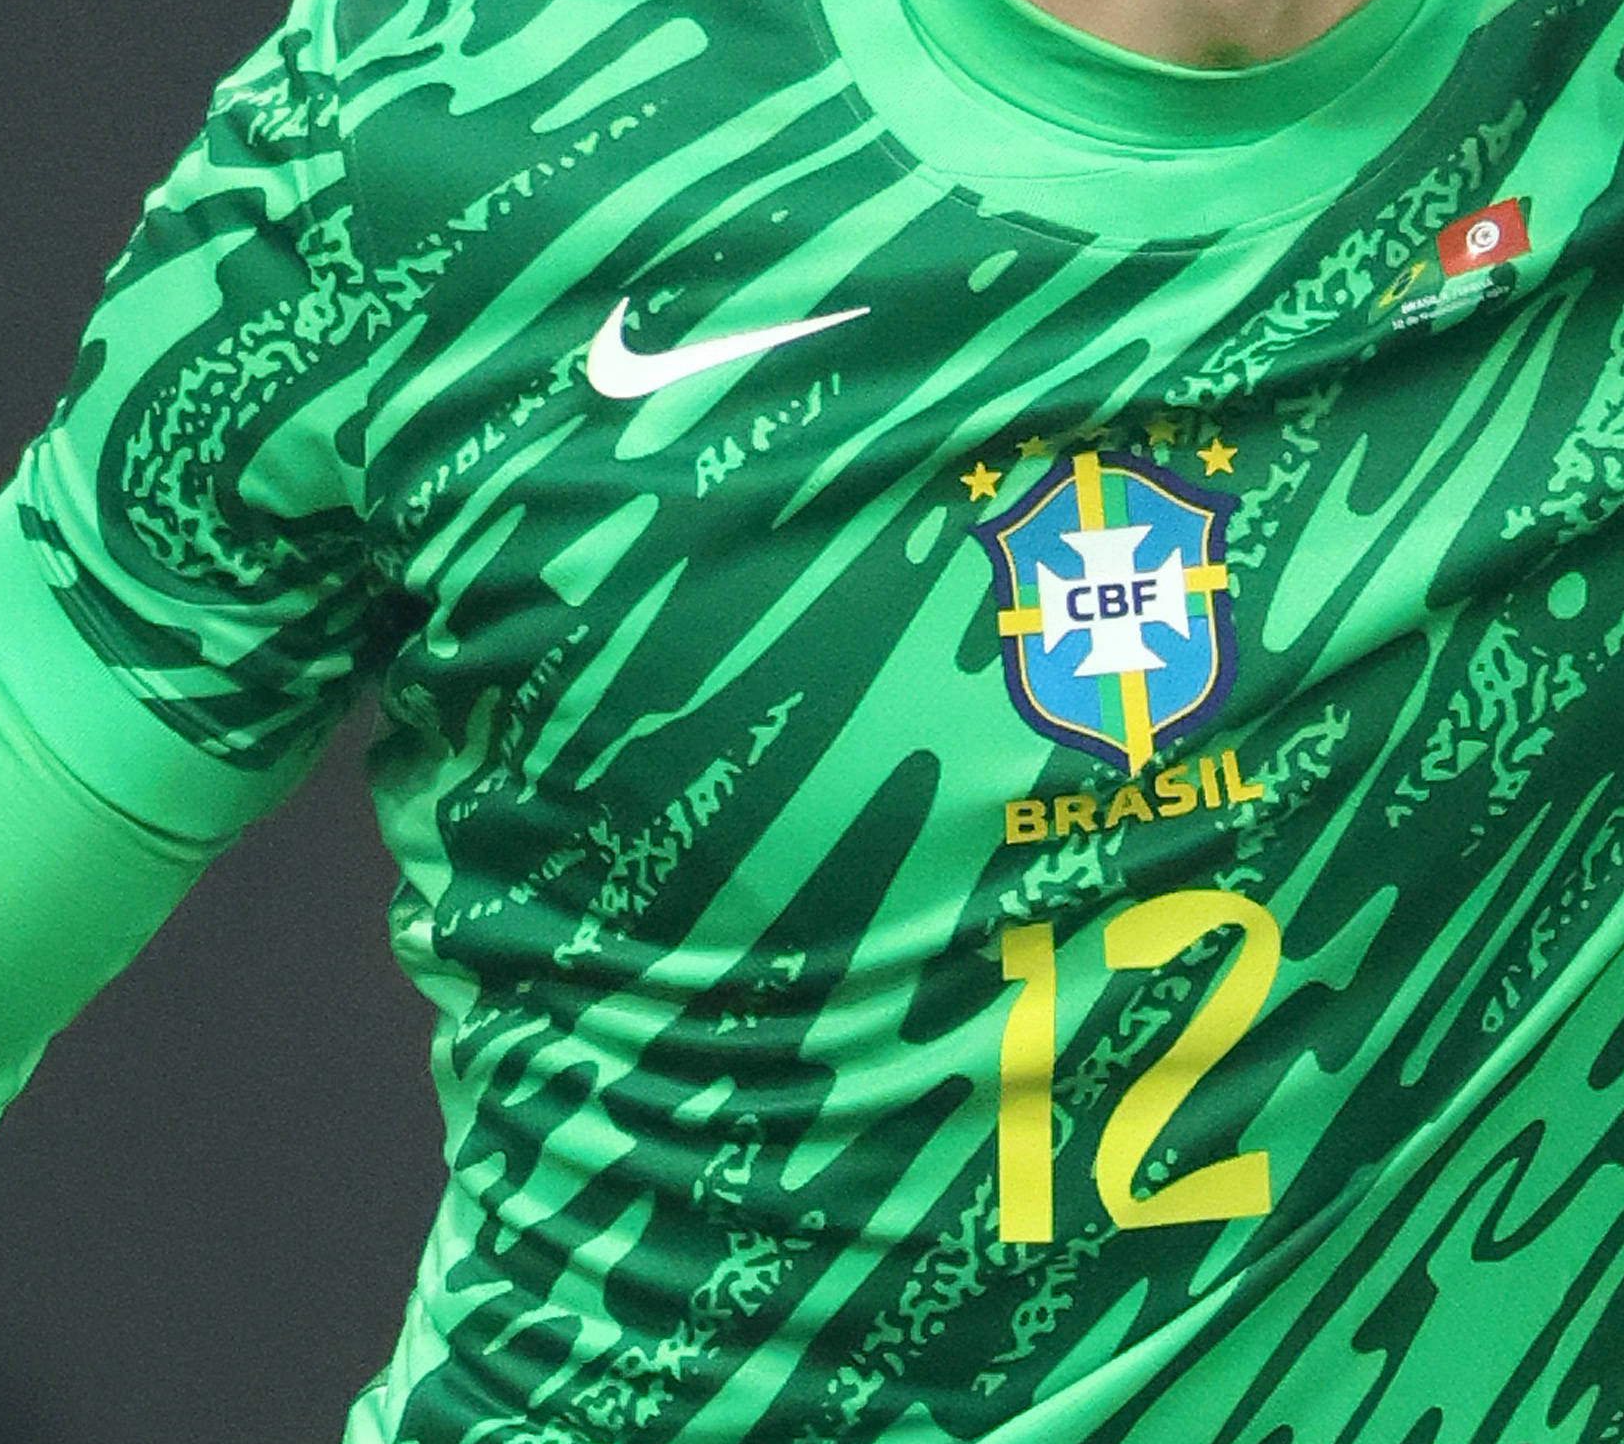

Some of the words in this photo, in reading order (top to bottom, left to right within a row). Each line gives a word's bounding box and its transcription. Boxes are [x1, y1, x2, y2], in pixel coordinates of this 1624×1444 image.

[1065, 575, 1158, 623] CBF
[1004, 750, 1263, 846] BRASIL
[998, 889, 1282, 1242] 12
